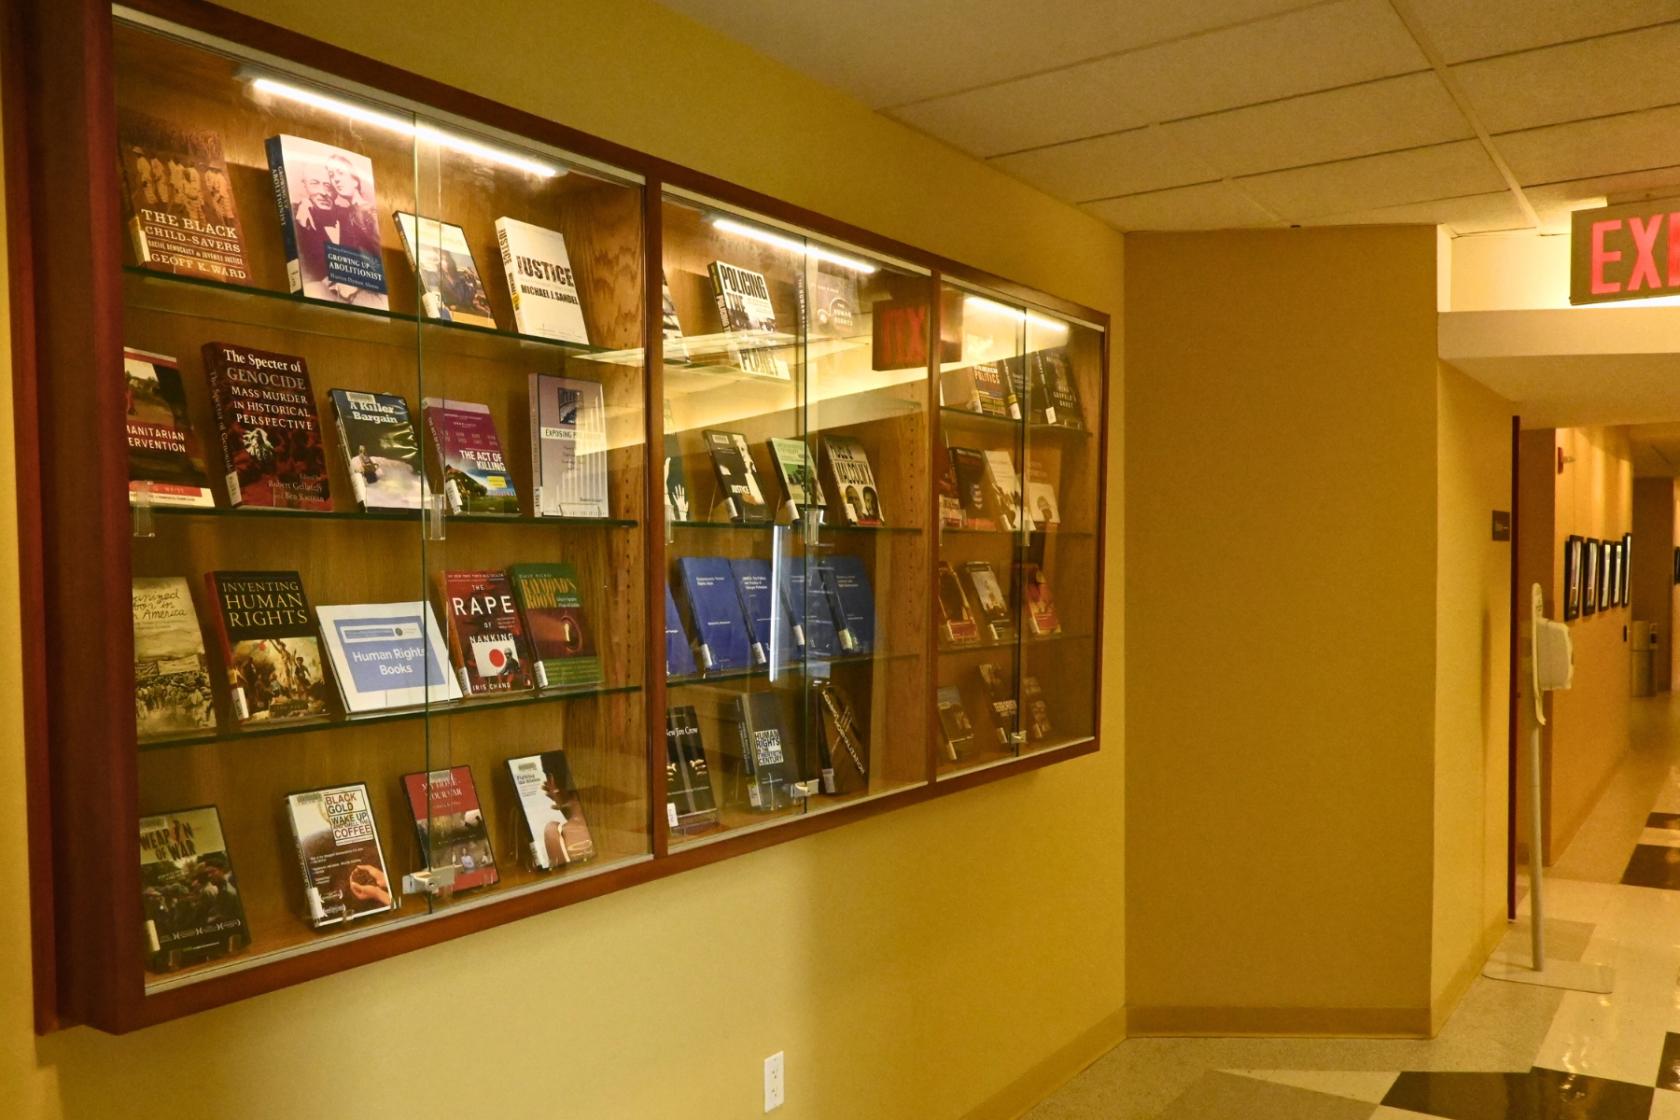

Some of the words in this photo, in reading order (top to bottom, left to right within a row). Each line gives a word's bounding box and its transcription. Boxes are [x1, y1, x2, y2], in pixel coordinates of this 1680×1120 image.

[141, 208, 178, 227] THE
[182, 217, 238, 239] BLACK
[144, 226, 240, 252] CHILD-SAVERS
[498, 228, 512, 266] JUSTICE
[151, 253, 193, 269] GEOFF
[210, 264, 246, 279] WARD
[327, 253, 360, 267] GROWING
[362, 261, 370, 270] UP
[328, 262, 382, 281] ABOLITIONIST
[516, 255, 575, 288] JUSTICE
[720, 264, 768, 300] POLICING
[520, 284, 550, 299] MICHAEL
[554, 292, 579, 306] SANDEL
[223, 348, 246, 364] The
[248, 354, 288, 372] Specter
[290, 361, 302, 373] of
[226, 366, 306, 391] GENOCIDE
[231, 386, 260, 399] MASS
[262, 390, 308, 404] MURDER
[234, 400, 244, 410] IN
[247, 402, 311, 418] HISTORICAL
[360, 400, 394, 414] Killer
[236, 413, 314, 432] PERSPECTIVE
[352, 410, 398, 424] Bargain
[126, 424, 185, 442] ANITARIAN
[128, 437, 186, 453] ERVENTION
[459, 450, 476, 460] THE
[476, 451, 491, 462] ACT
[492, 453, 502, 462] OF
[476, 460, 506, 472] KILLING
[222, 581, 299, 593] INVENTING
[225, 592, 303, 610] HUMAN
[452, 595, 514, 616] RAPE
[228, 610, 308, 628] RIGHTS
[469, 632, 514, 644] NANKING
[352, 651, 392, 662] Human
[393, 648, 425, 661] Rights
[379, 664, 413, 676] Books
[325, 792, 357, 806] BLACK
[328, 802, 354, 814] GOLD
[330, 812, 356, 826] WAKE
[356, 812, 368, 821] UP
[334, 824, 371, 839] COFFEE
